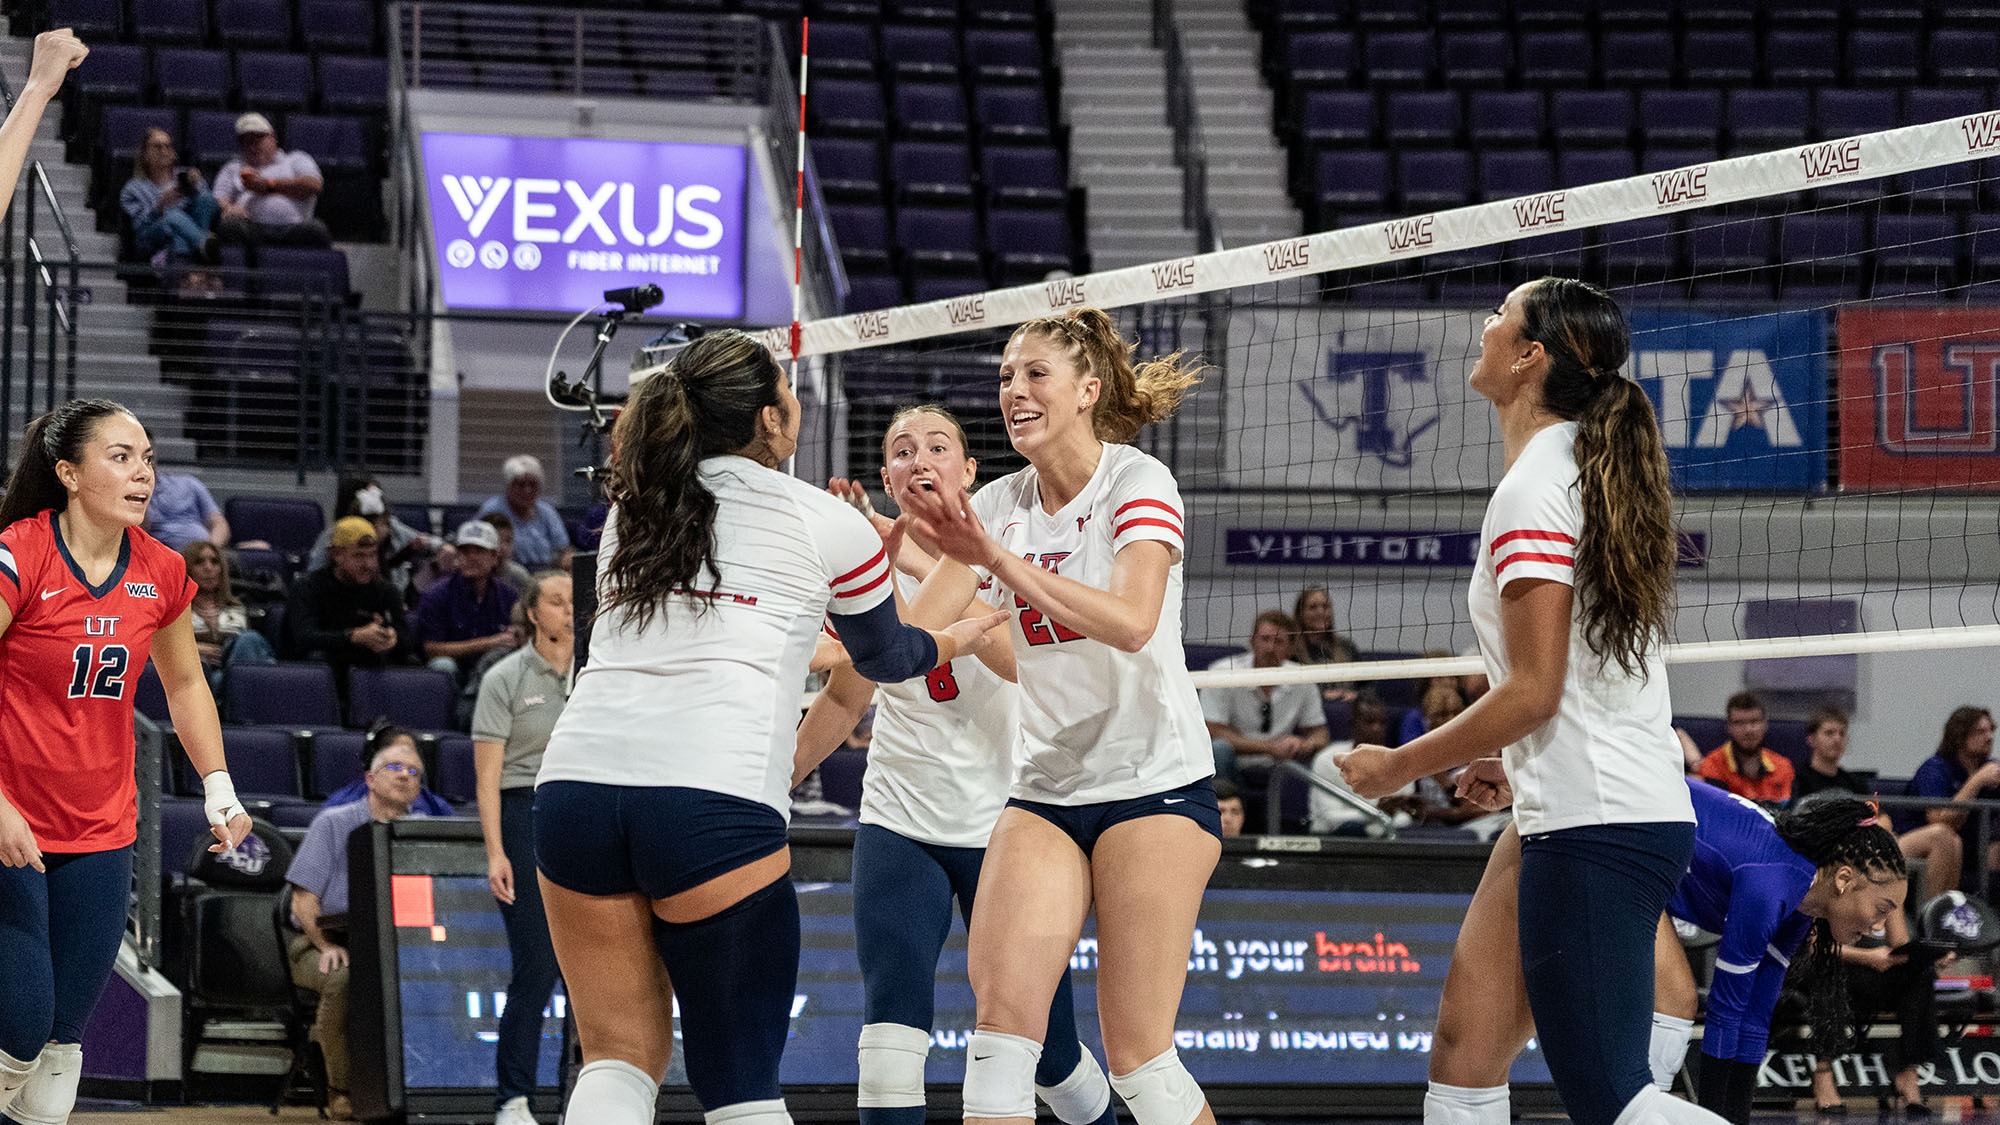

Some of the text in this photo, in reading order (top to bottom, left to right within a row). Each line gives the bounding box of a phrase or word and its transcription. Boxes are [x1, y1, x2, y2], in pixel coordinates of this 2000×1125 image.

[1962, 113, 2000, 149] WA
[1800, 138, 1861, 178] WAC
[1652, 165, 1708, 204] WAC
[441, 174, 724, 249] VEXUS
[1513, 192, 1566, 228] WAC
[1385, 215, 1434, 250] WAC
[567, 249, 721, 275] FIBER INTERNET
[1264, 239, 1309, 271] WAC
[1152, 259, 1195, 290] WAC
[946, 293, 985, 324] WAC
[1046, 279, 1086, 309] WAC
[766, 326, 794, 352] WA
[854, 310, 889, 341] WAC
[1620, 350, 1803, 448] TA
[1250, 535, 1442, 561] VISITOR
[124, 582, 158, 599] WAC
[67, 644, 129, 700] 12
[1224, 941, 1308, 979] your
[1316, 932, 1421, 973] brain.
